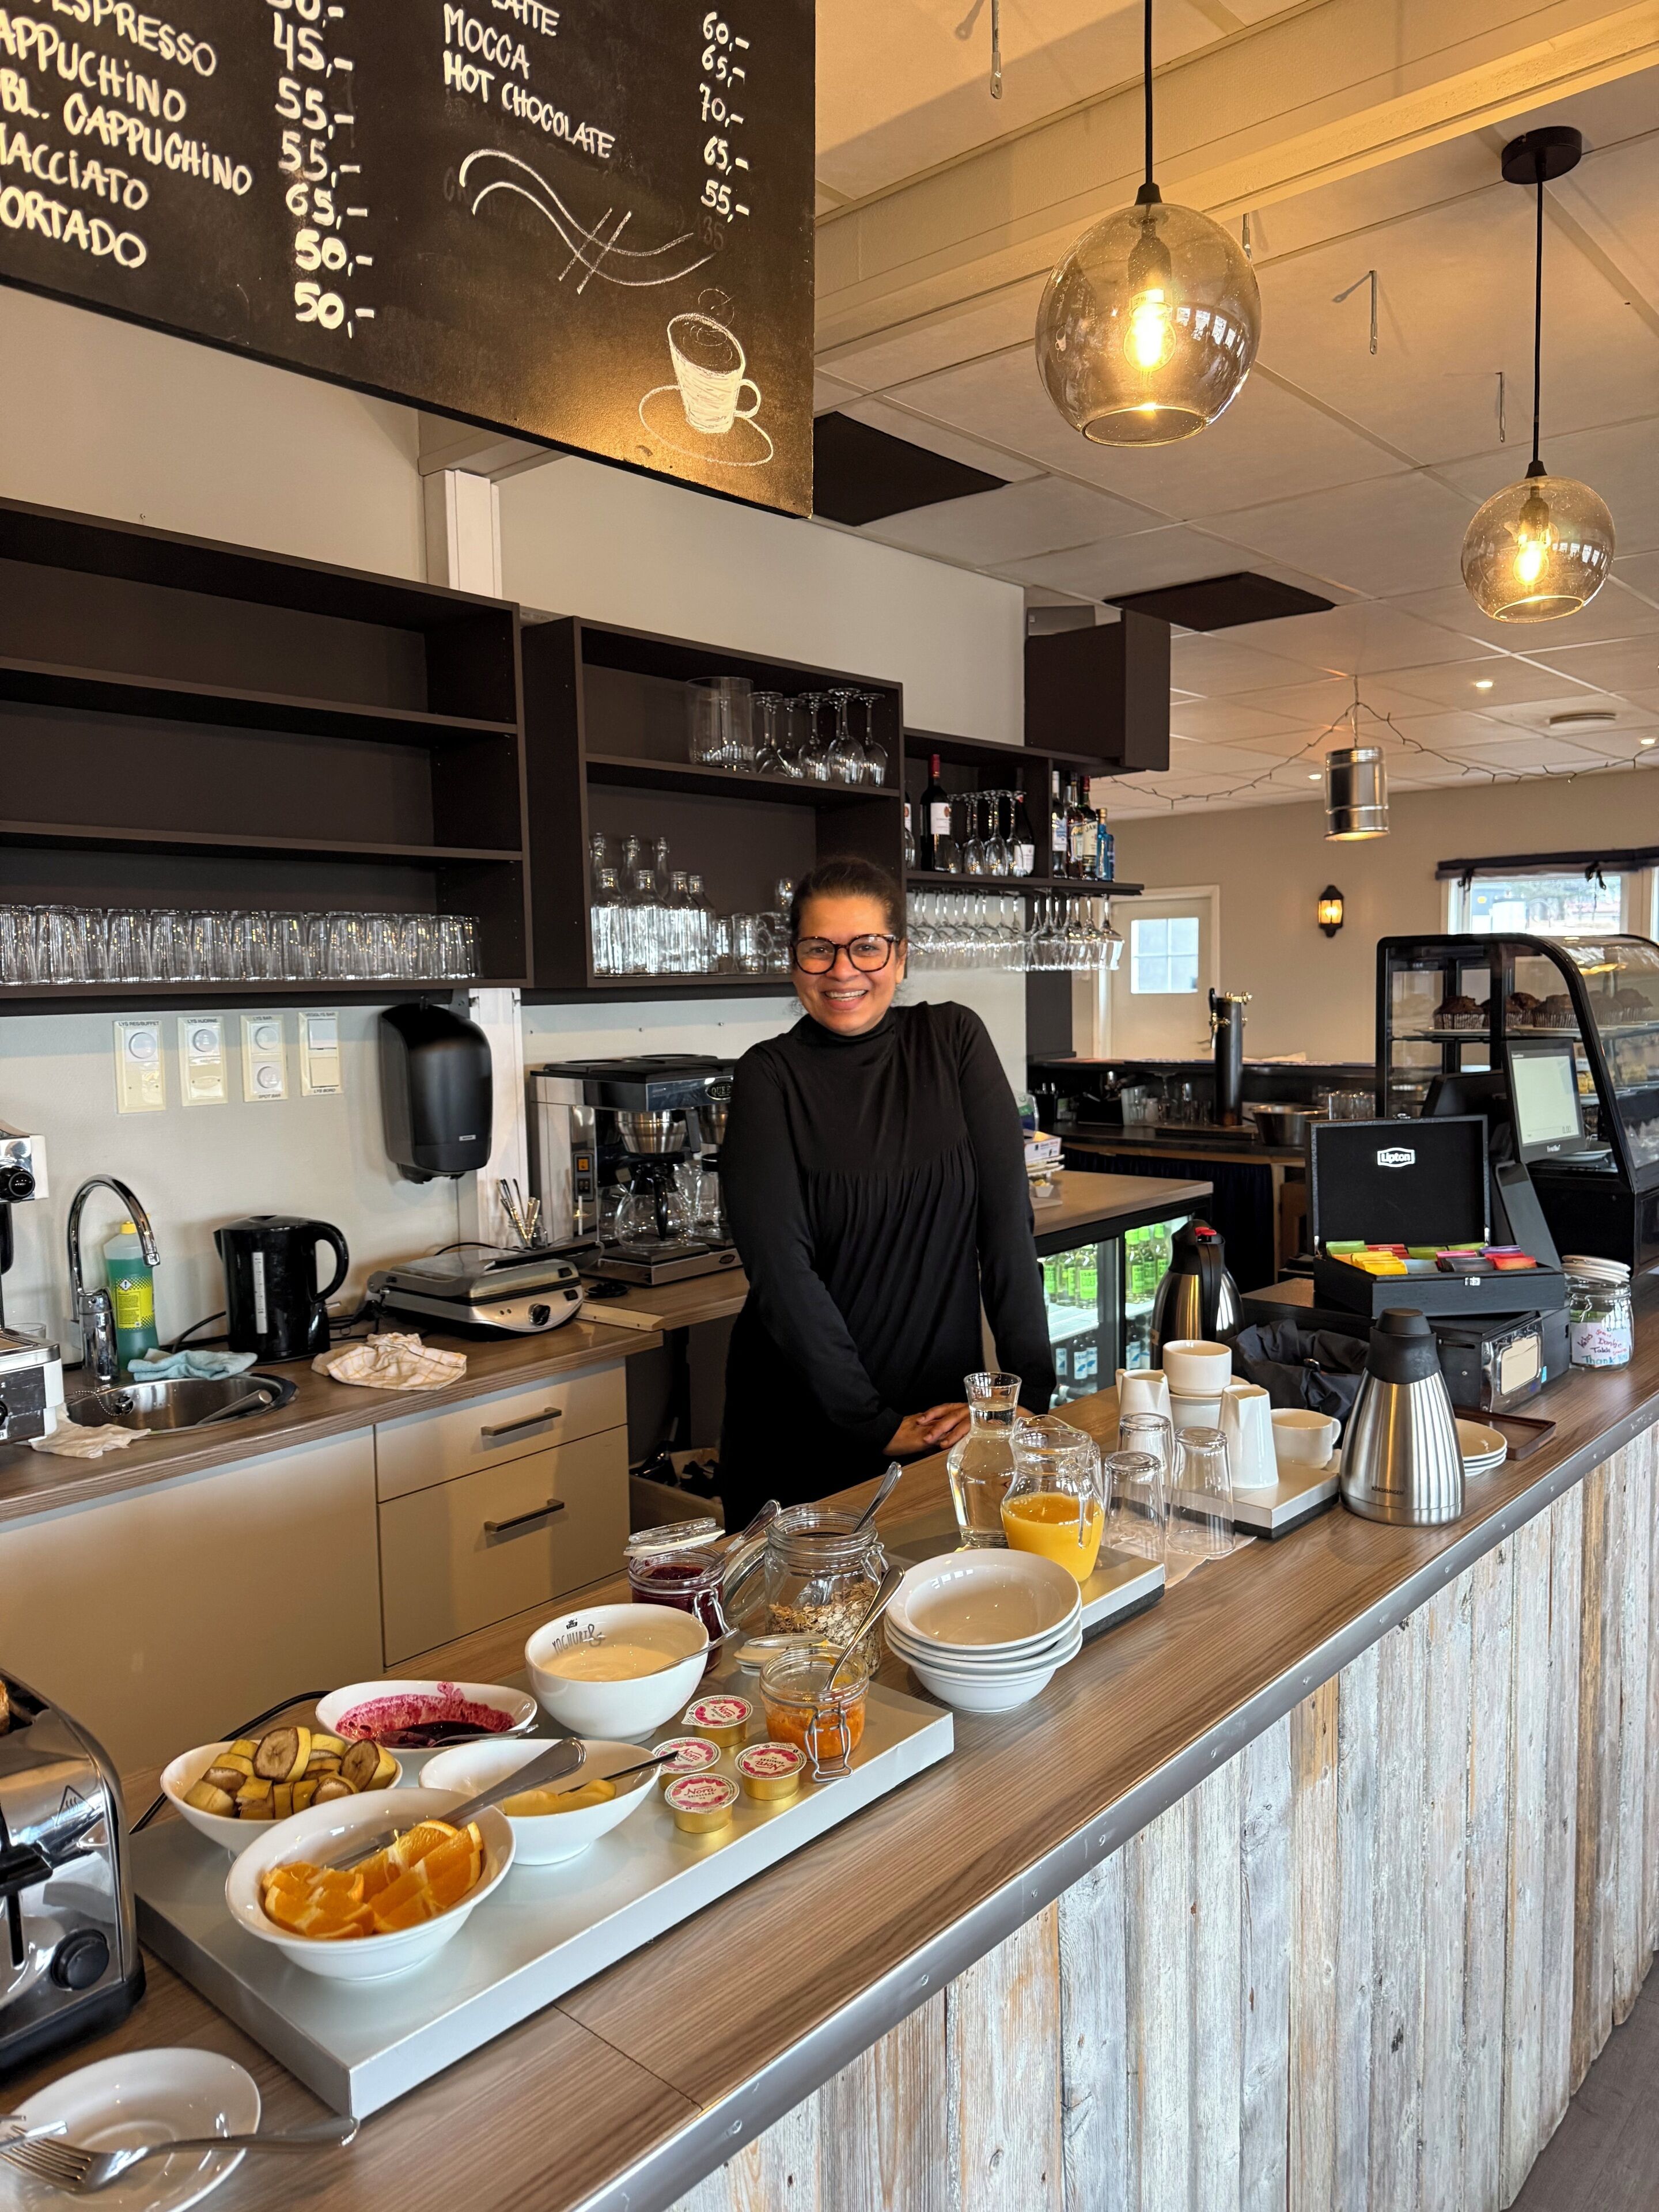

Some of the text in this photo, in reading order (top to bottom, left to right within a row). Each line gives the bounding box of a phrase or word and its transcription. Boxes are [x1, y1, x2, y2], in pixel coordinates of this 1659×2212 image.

[265, 0, 344, 28] 0,-
[491, 0, 559, 36] ATTE
[703, 12, 749, 52] 60,-
[274, 12, 353, 78] 45,-
[444, 3, 529, 79] MOCCA
[702, 44, 745, 88] 65,-
[275, 77, 354, 139] 55,-
[443, 50, 615, 158] HOT CHOCOLATE
[699, 82, 744, 128] 70,-
[279, 131, 361, 188] 55,-
[704, 136, 749, 176] 65,-
[286, 183, 368, 230] 65,-
[700, 179, 749, 223] 55,-
[0, 186, 146, 268] ORTADO
[295, 229, 373, 277] 50,-
[294, 282, 375, 339] 50,-
[1381, 1152, 1411, 1164] Lipton
[755, 1760, 785, 1771] Nora
[684, 1786, 716, 1796] Nora
